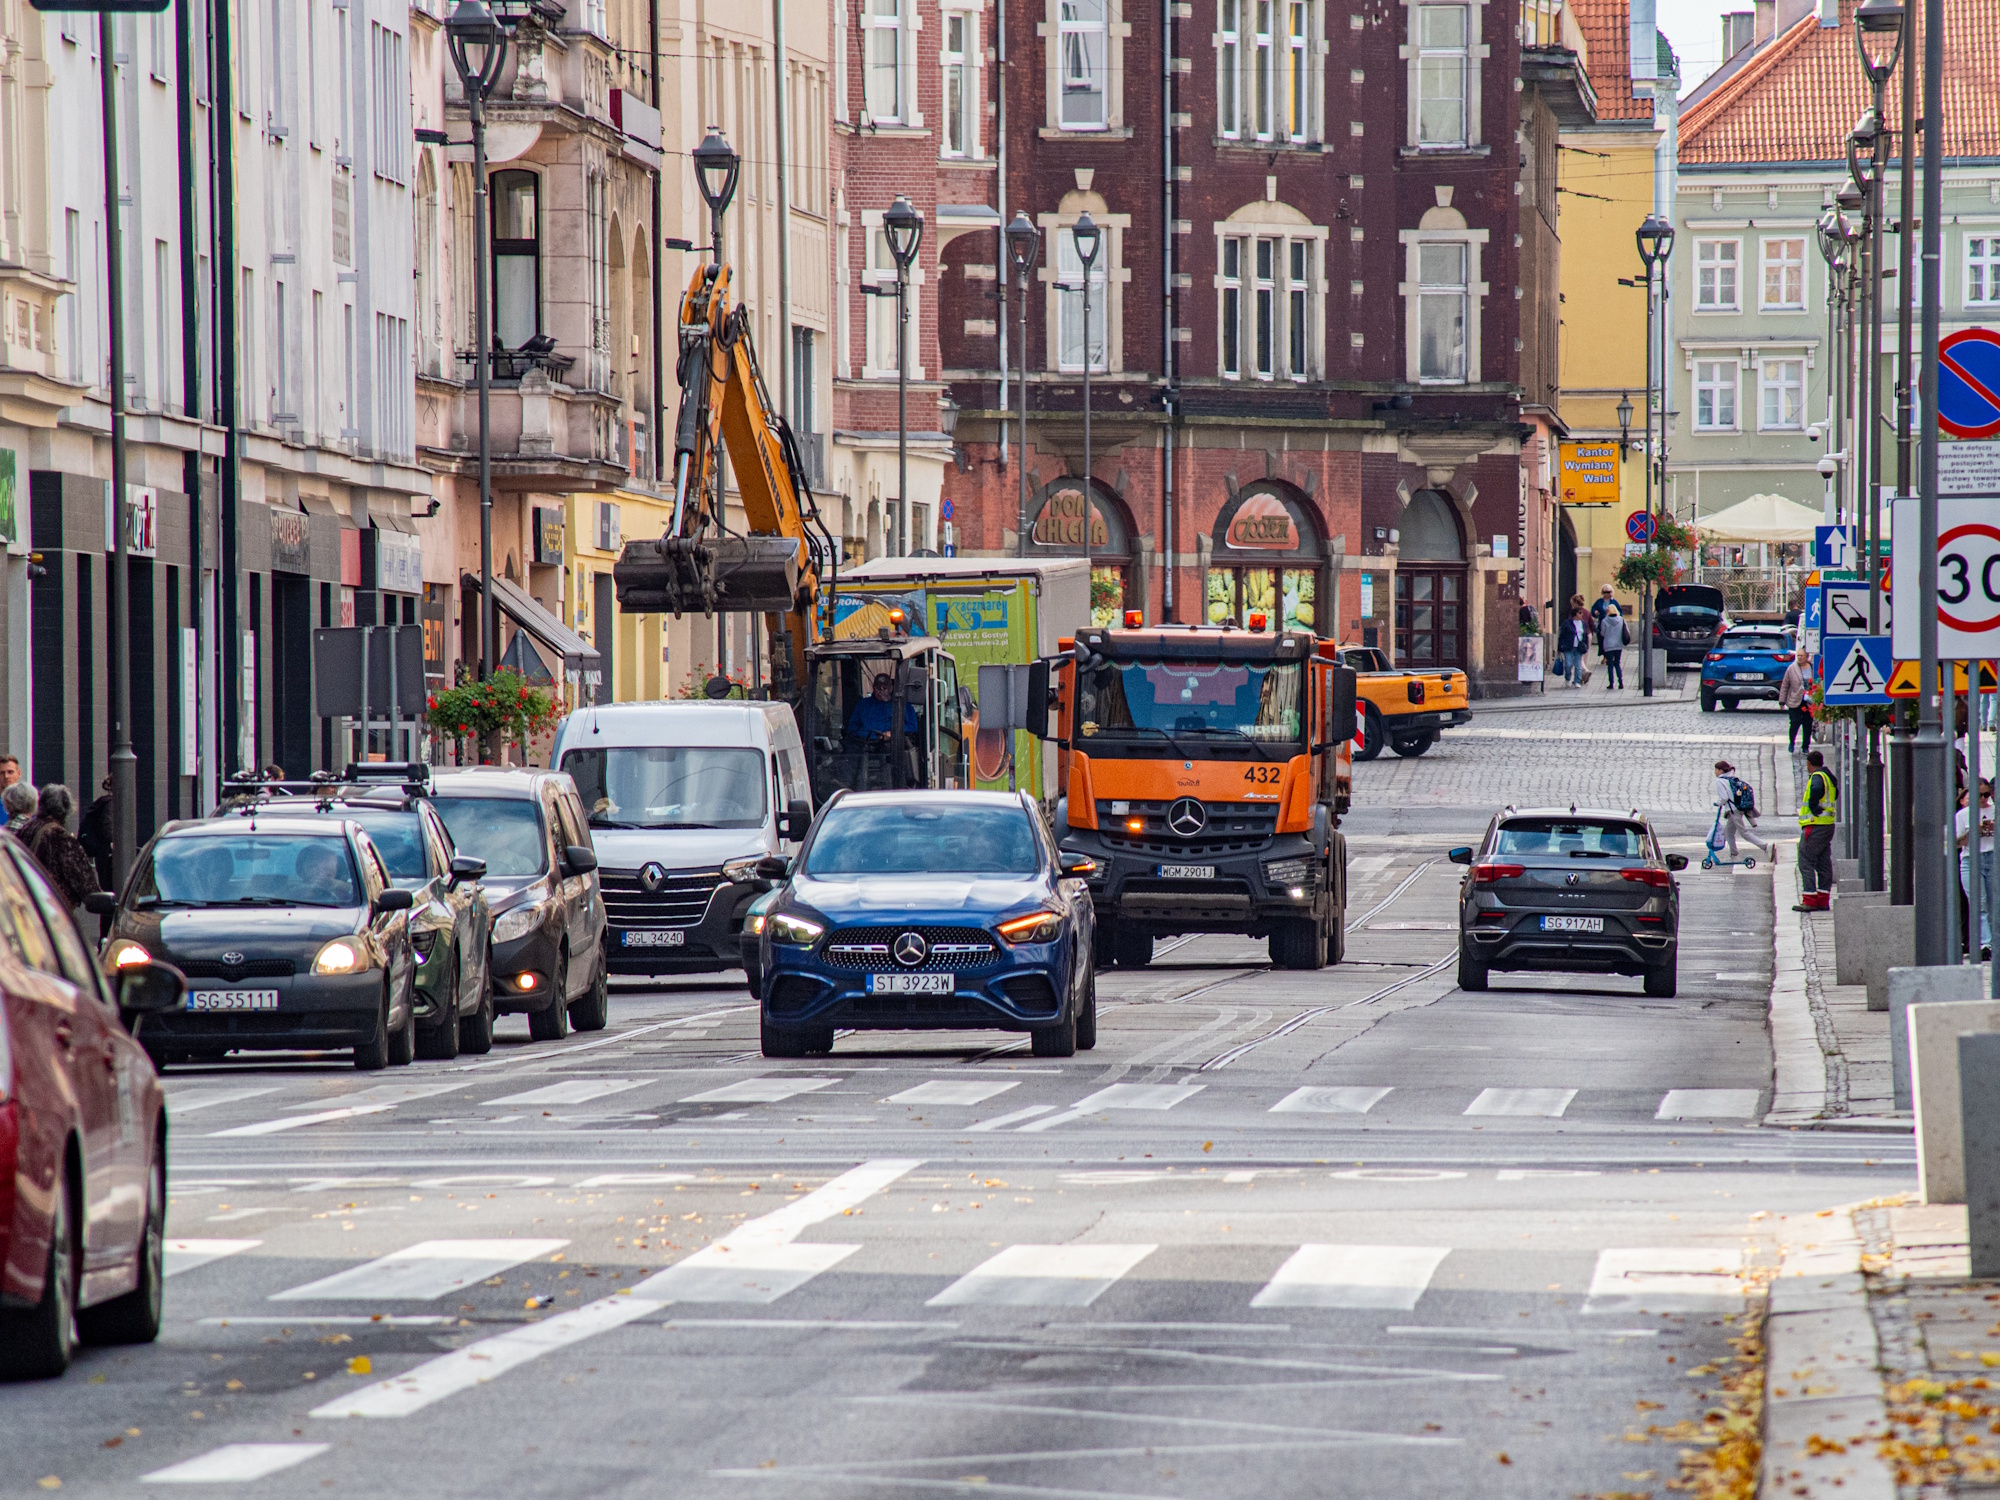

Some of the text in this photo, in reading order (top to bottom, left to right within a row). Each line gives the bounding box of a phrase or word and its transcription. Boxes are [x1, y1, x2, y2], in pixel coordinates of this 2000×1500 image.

[1577, 448, 1614, 458] Kantor
[1564, 461, 1614, 473] Wymiany
[1583, 474, 1614, 483] Walut
[1938, 553, 2000, 604] 30
[424, 619, 443, 661] BUTY
[982, 632, 1008, 641] Gostyń
[1244, 766, 1280, 784] 432
[1163, 866, 1213, 877] WGM 2901J
[1547, 918, 1601, 930] SG 917AH
[627, 933, 683, 944] SGL 34240
[877, 976, 896, 990] ST
[902, 975, 950, 990] 3923W
[196, 993, 274, 1009] SG 55111
[1056, 1169, 1603, 1185] STOP
[167, 1174, 697, 1196] STOP
